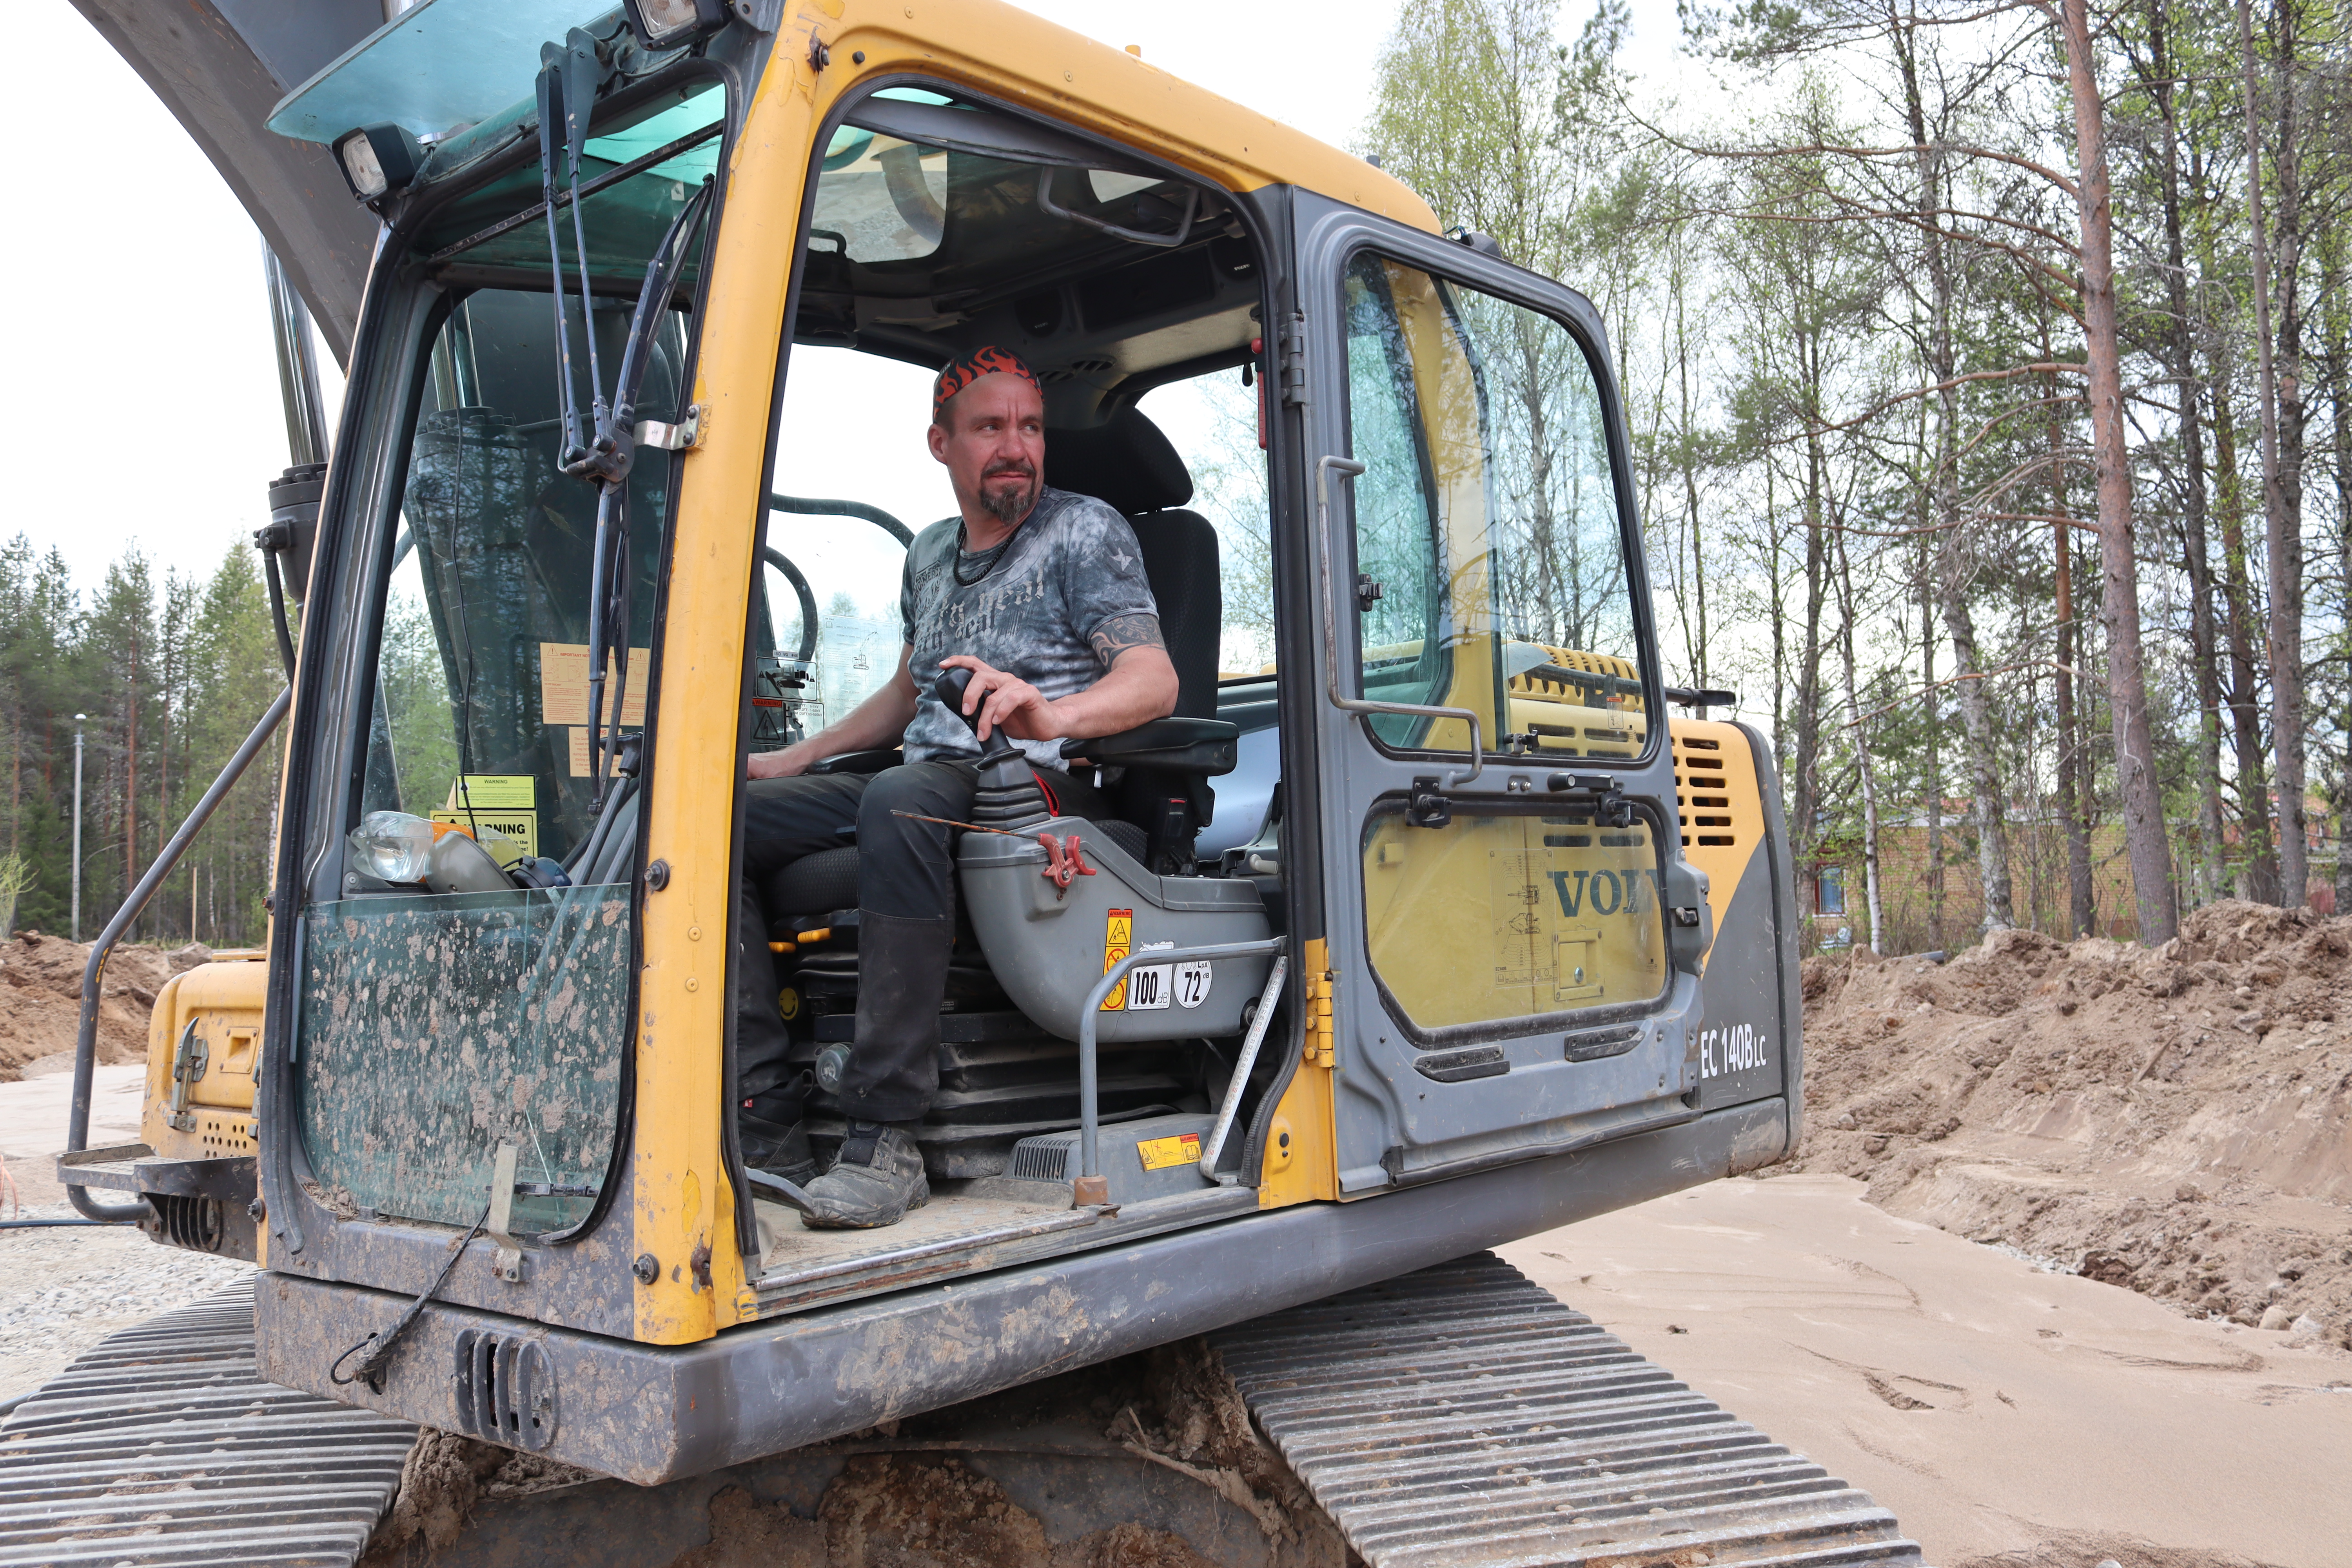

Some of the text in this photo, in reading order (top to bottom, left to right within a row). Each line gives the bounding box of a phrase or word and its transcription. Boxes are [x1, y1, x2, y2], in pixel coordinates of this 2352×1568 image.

[464, 824, 525, 834] NING
[1547, 869, 1661, 917] VOL
[1134, 971, 1168, 1004] 100 dB
[1184, 971, 1201, 1002] 72
[1701, 1029, 1718, 1079] EC
